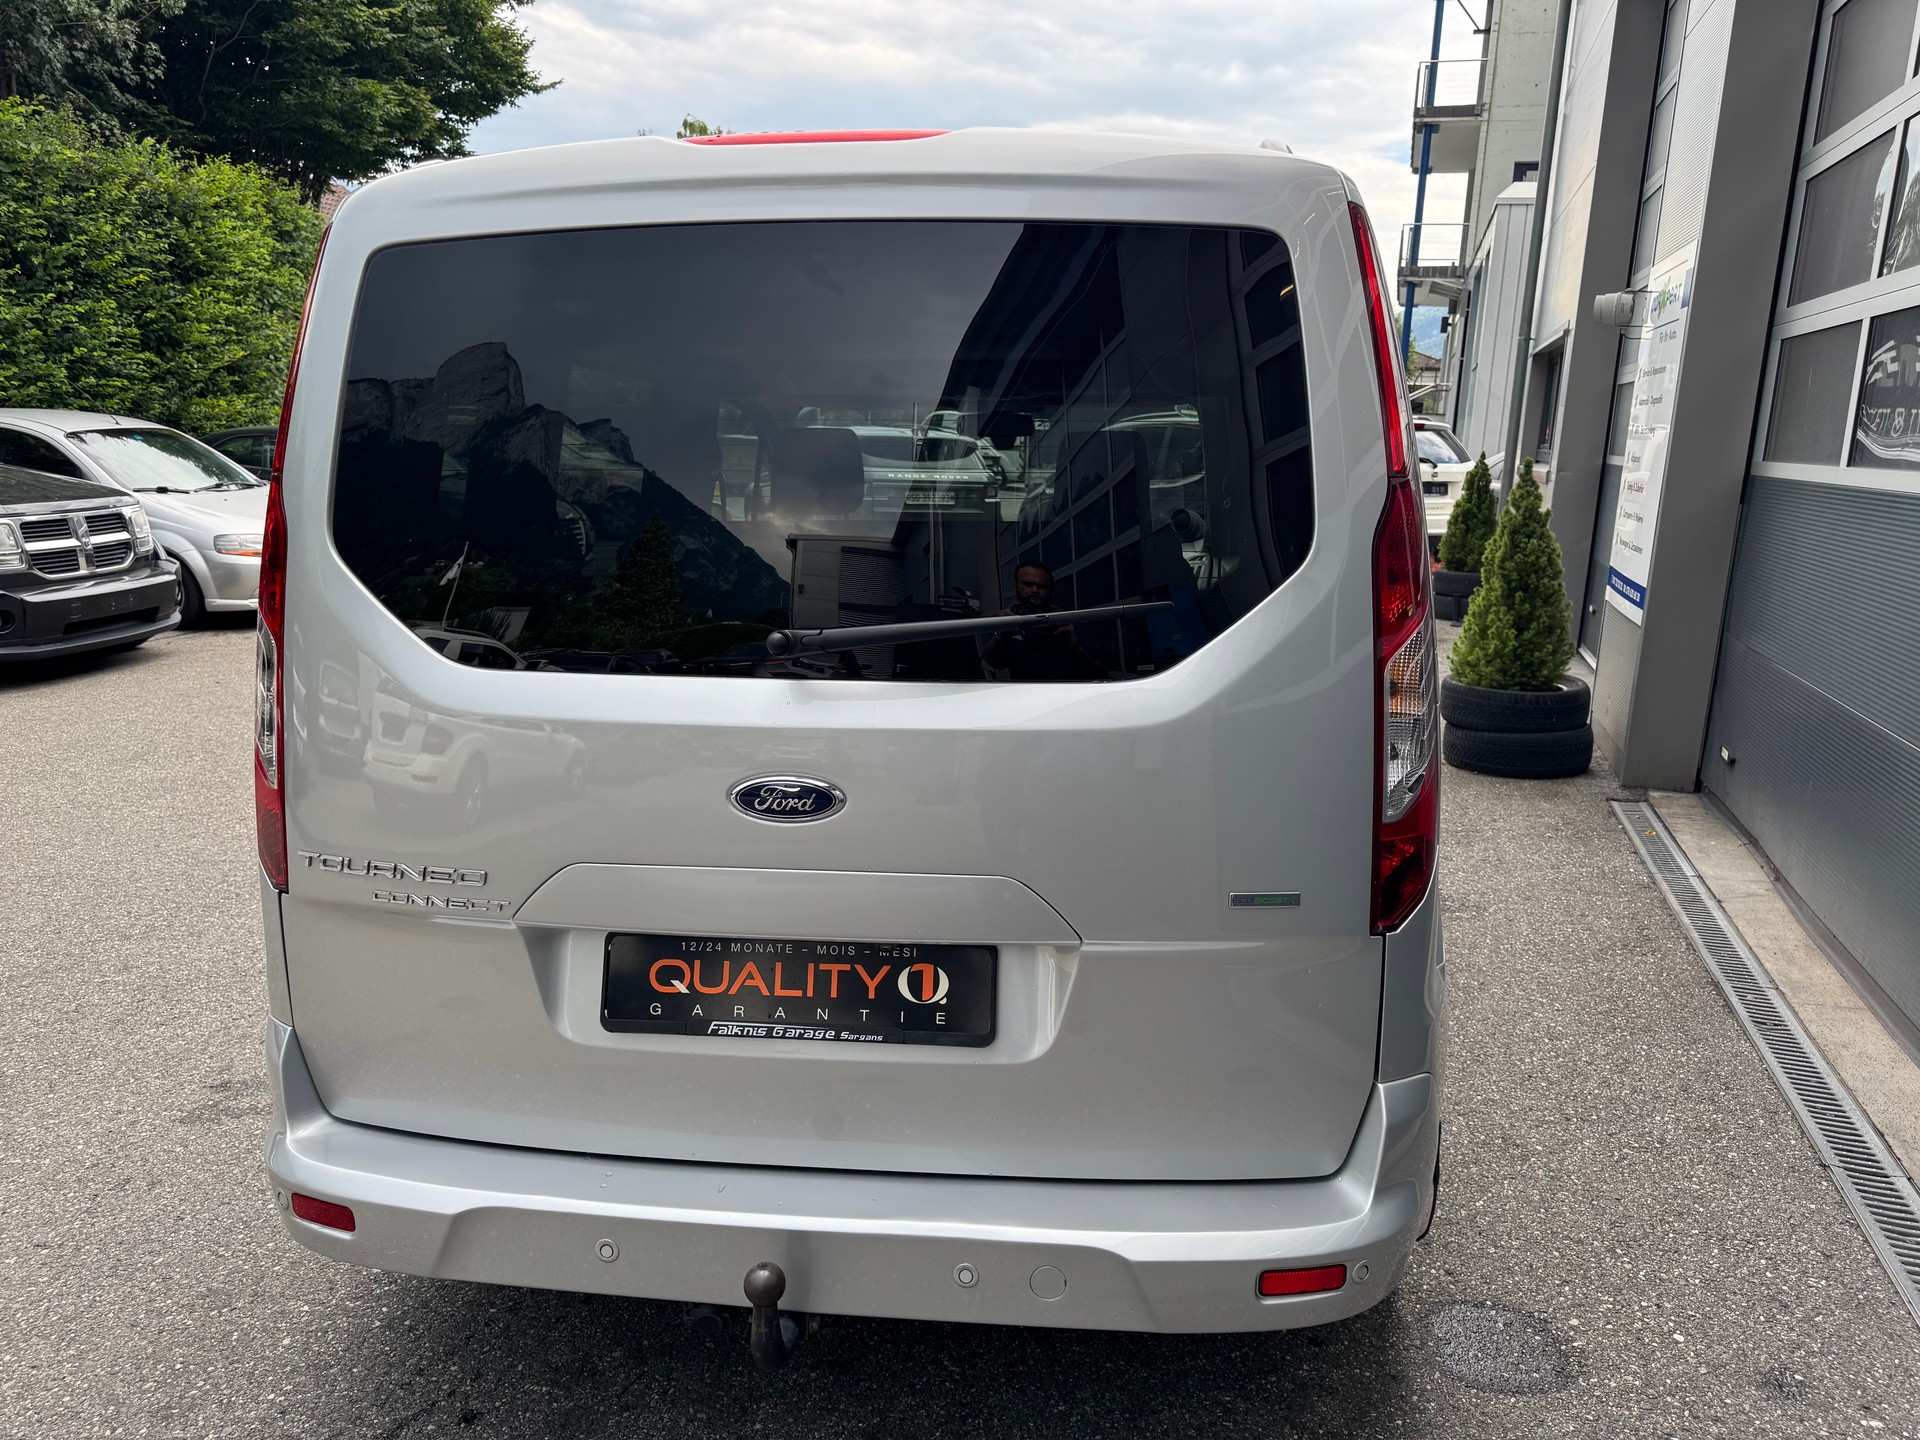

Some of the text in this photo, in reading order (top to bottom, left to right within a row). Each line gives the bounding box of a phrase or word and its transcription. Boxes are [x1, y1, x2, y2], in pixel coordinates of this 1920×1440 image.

[754, 785, 817, 812] Ford
[298, 850, 488, 887] TOURNEO
[372, 889, 511, 912] CONNECT
[681, 942, 722, 952] 12/24
[730, 943, 794, 954] MONATE
[816, 945, 856, 956] MOIS
[649, 958, 892, 999] QUALITY
[649, 1002, 947, 1025] GARANTIE
[707, 1020, 884, 1042] Falknis Garage Sargans
